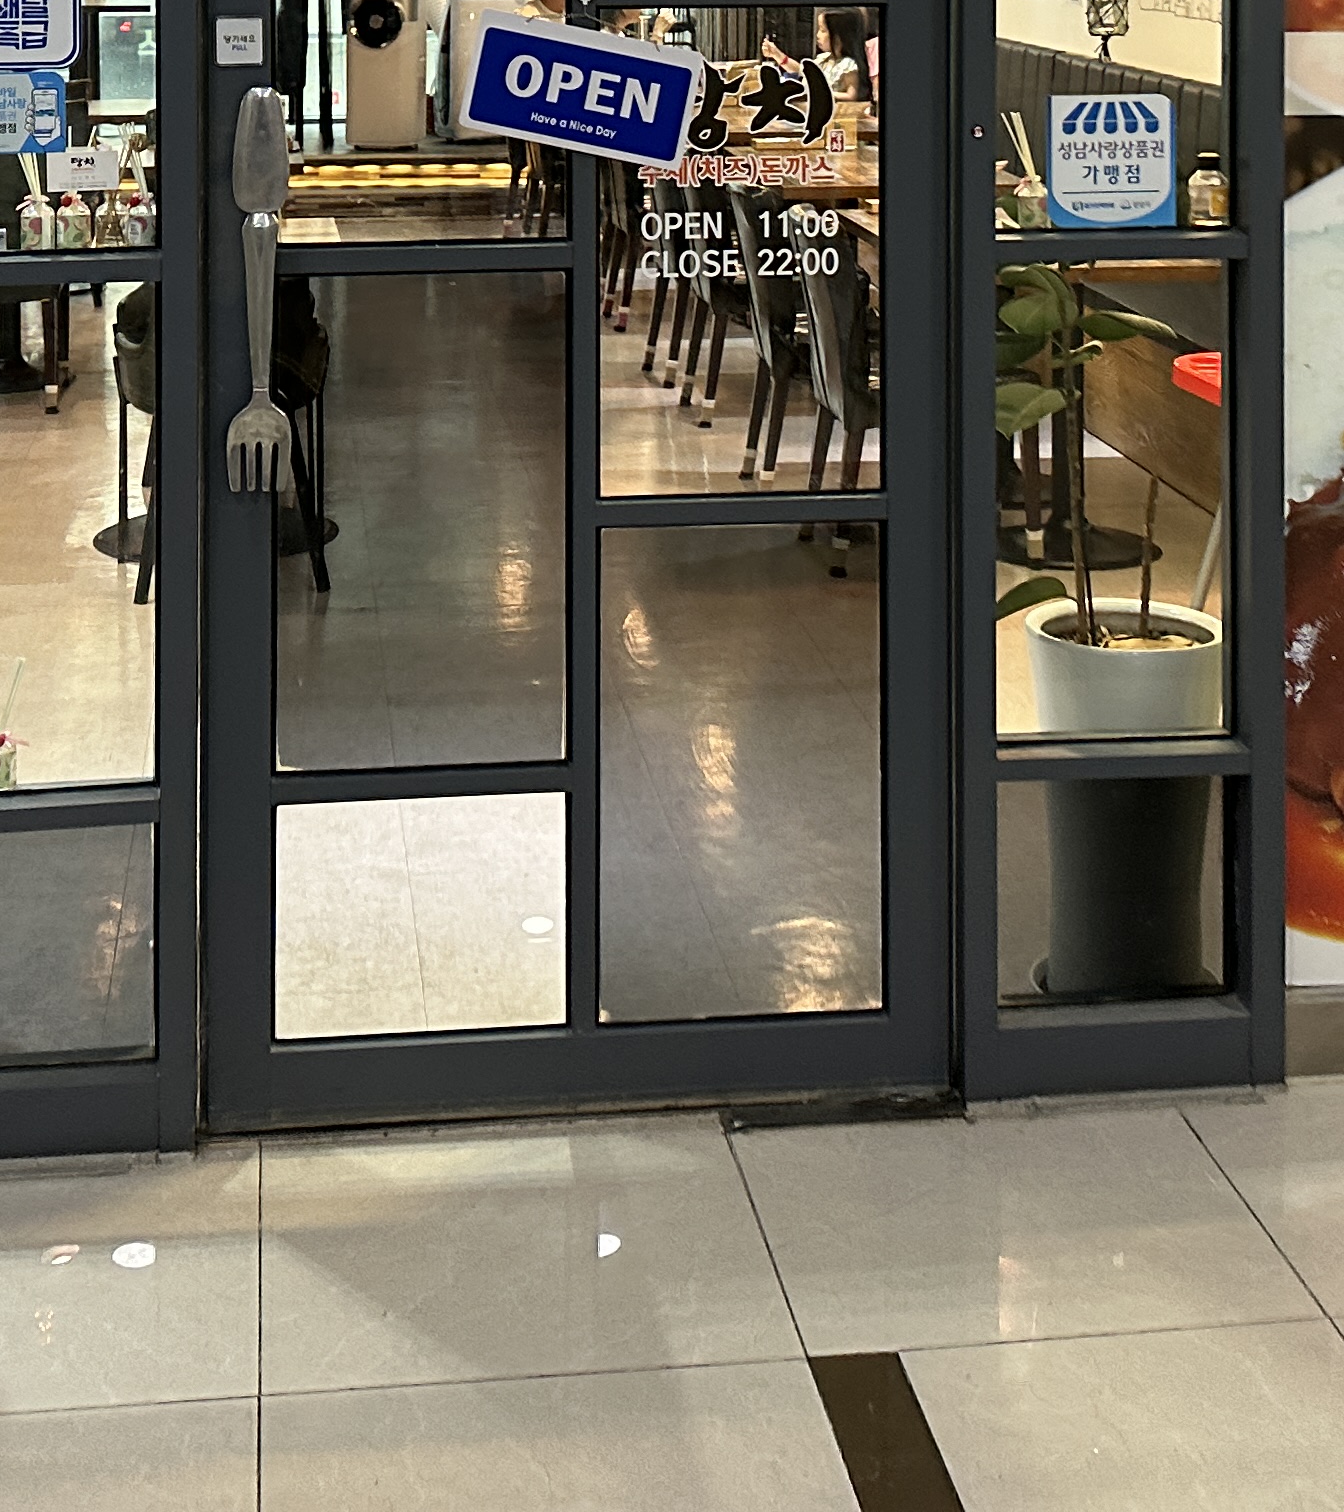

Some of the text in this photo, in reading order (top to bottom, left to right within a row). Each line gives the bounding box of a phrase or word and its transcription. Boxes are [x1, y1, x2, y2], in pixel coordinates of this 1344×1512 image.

[505, 54, 661, 124] OPEN
[530, 112, 617, 139] Have a Nice Day
[1058, 140, 1166, 160] 성남사랑상품권
[1082, 164, 1141, 185] 가맹점
[640, 211, 723, 240] OPEN
[640, 247, 839, 278] CLOSE 22:00
